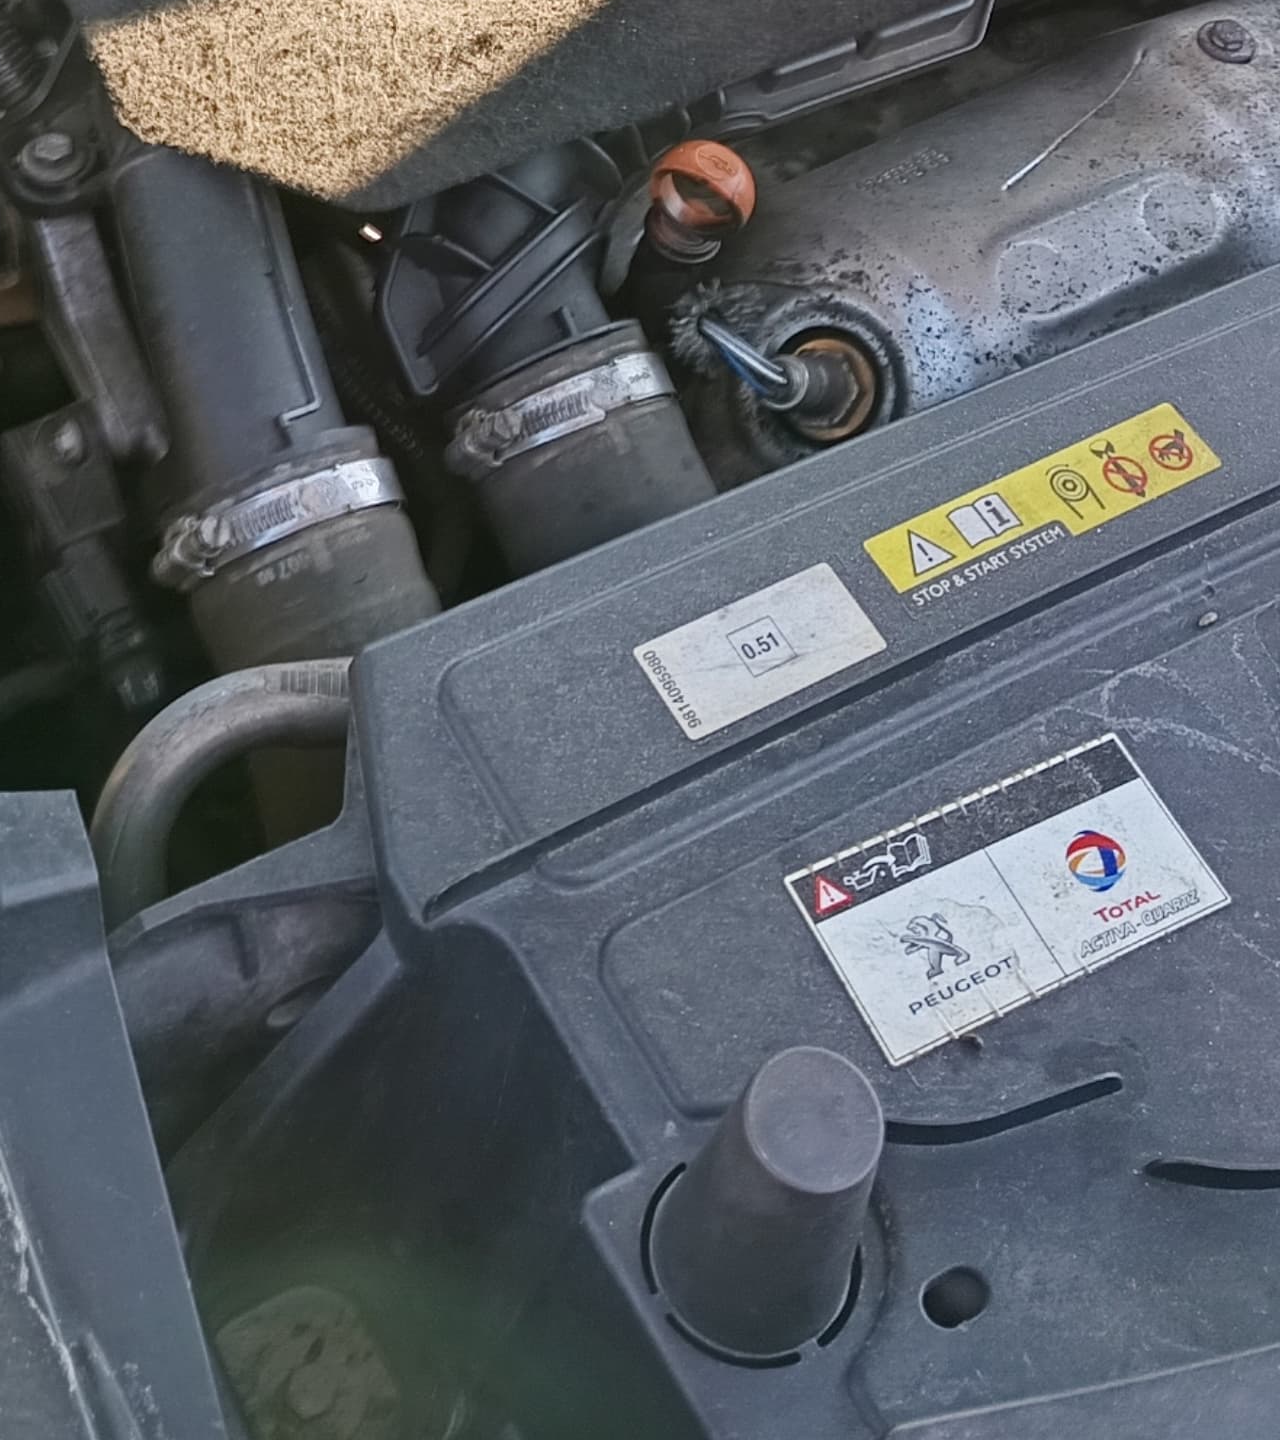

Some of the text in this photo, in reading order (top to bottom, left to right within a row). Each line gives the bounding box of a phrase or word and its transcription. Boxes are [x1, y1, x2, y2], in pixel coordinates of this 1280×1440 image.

[912, 526, 1065, 606] STOP & START SYSTEM
[741, 632, 780, 660] 0.51
[643, 650, 702, 729] 9814095980
[1093, 890, 1161, 923] TOTAL
[909, 956, 1014, 1015] PEUGEOT
